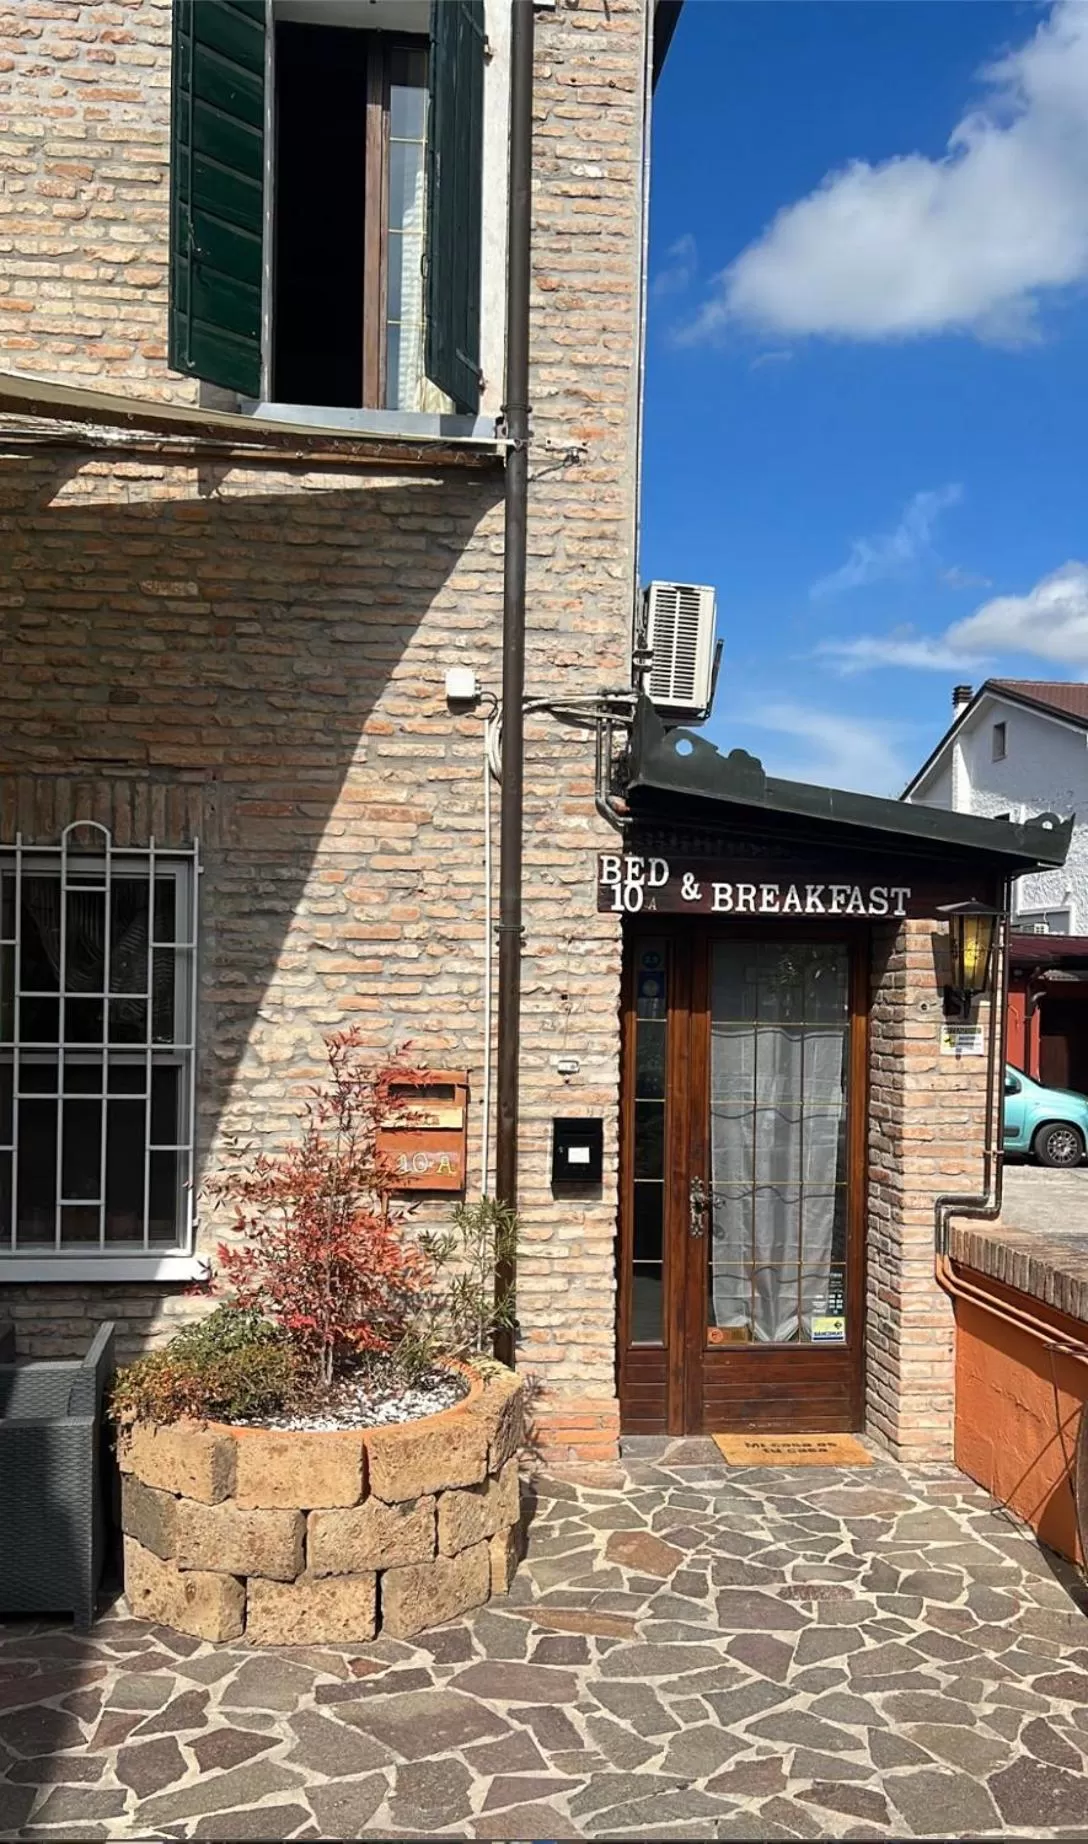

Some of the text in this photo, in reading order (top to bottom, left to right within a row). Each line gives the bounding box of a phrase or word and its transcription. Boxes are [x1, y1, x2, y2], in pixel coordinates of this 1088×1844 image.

[599, 855, 911, 916] BED & BREAKFAST
[610, 882, 657, 913] 10 A
